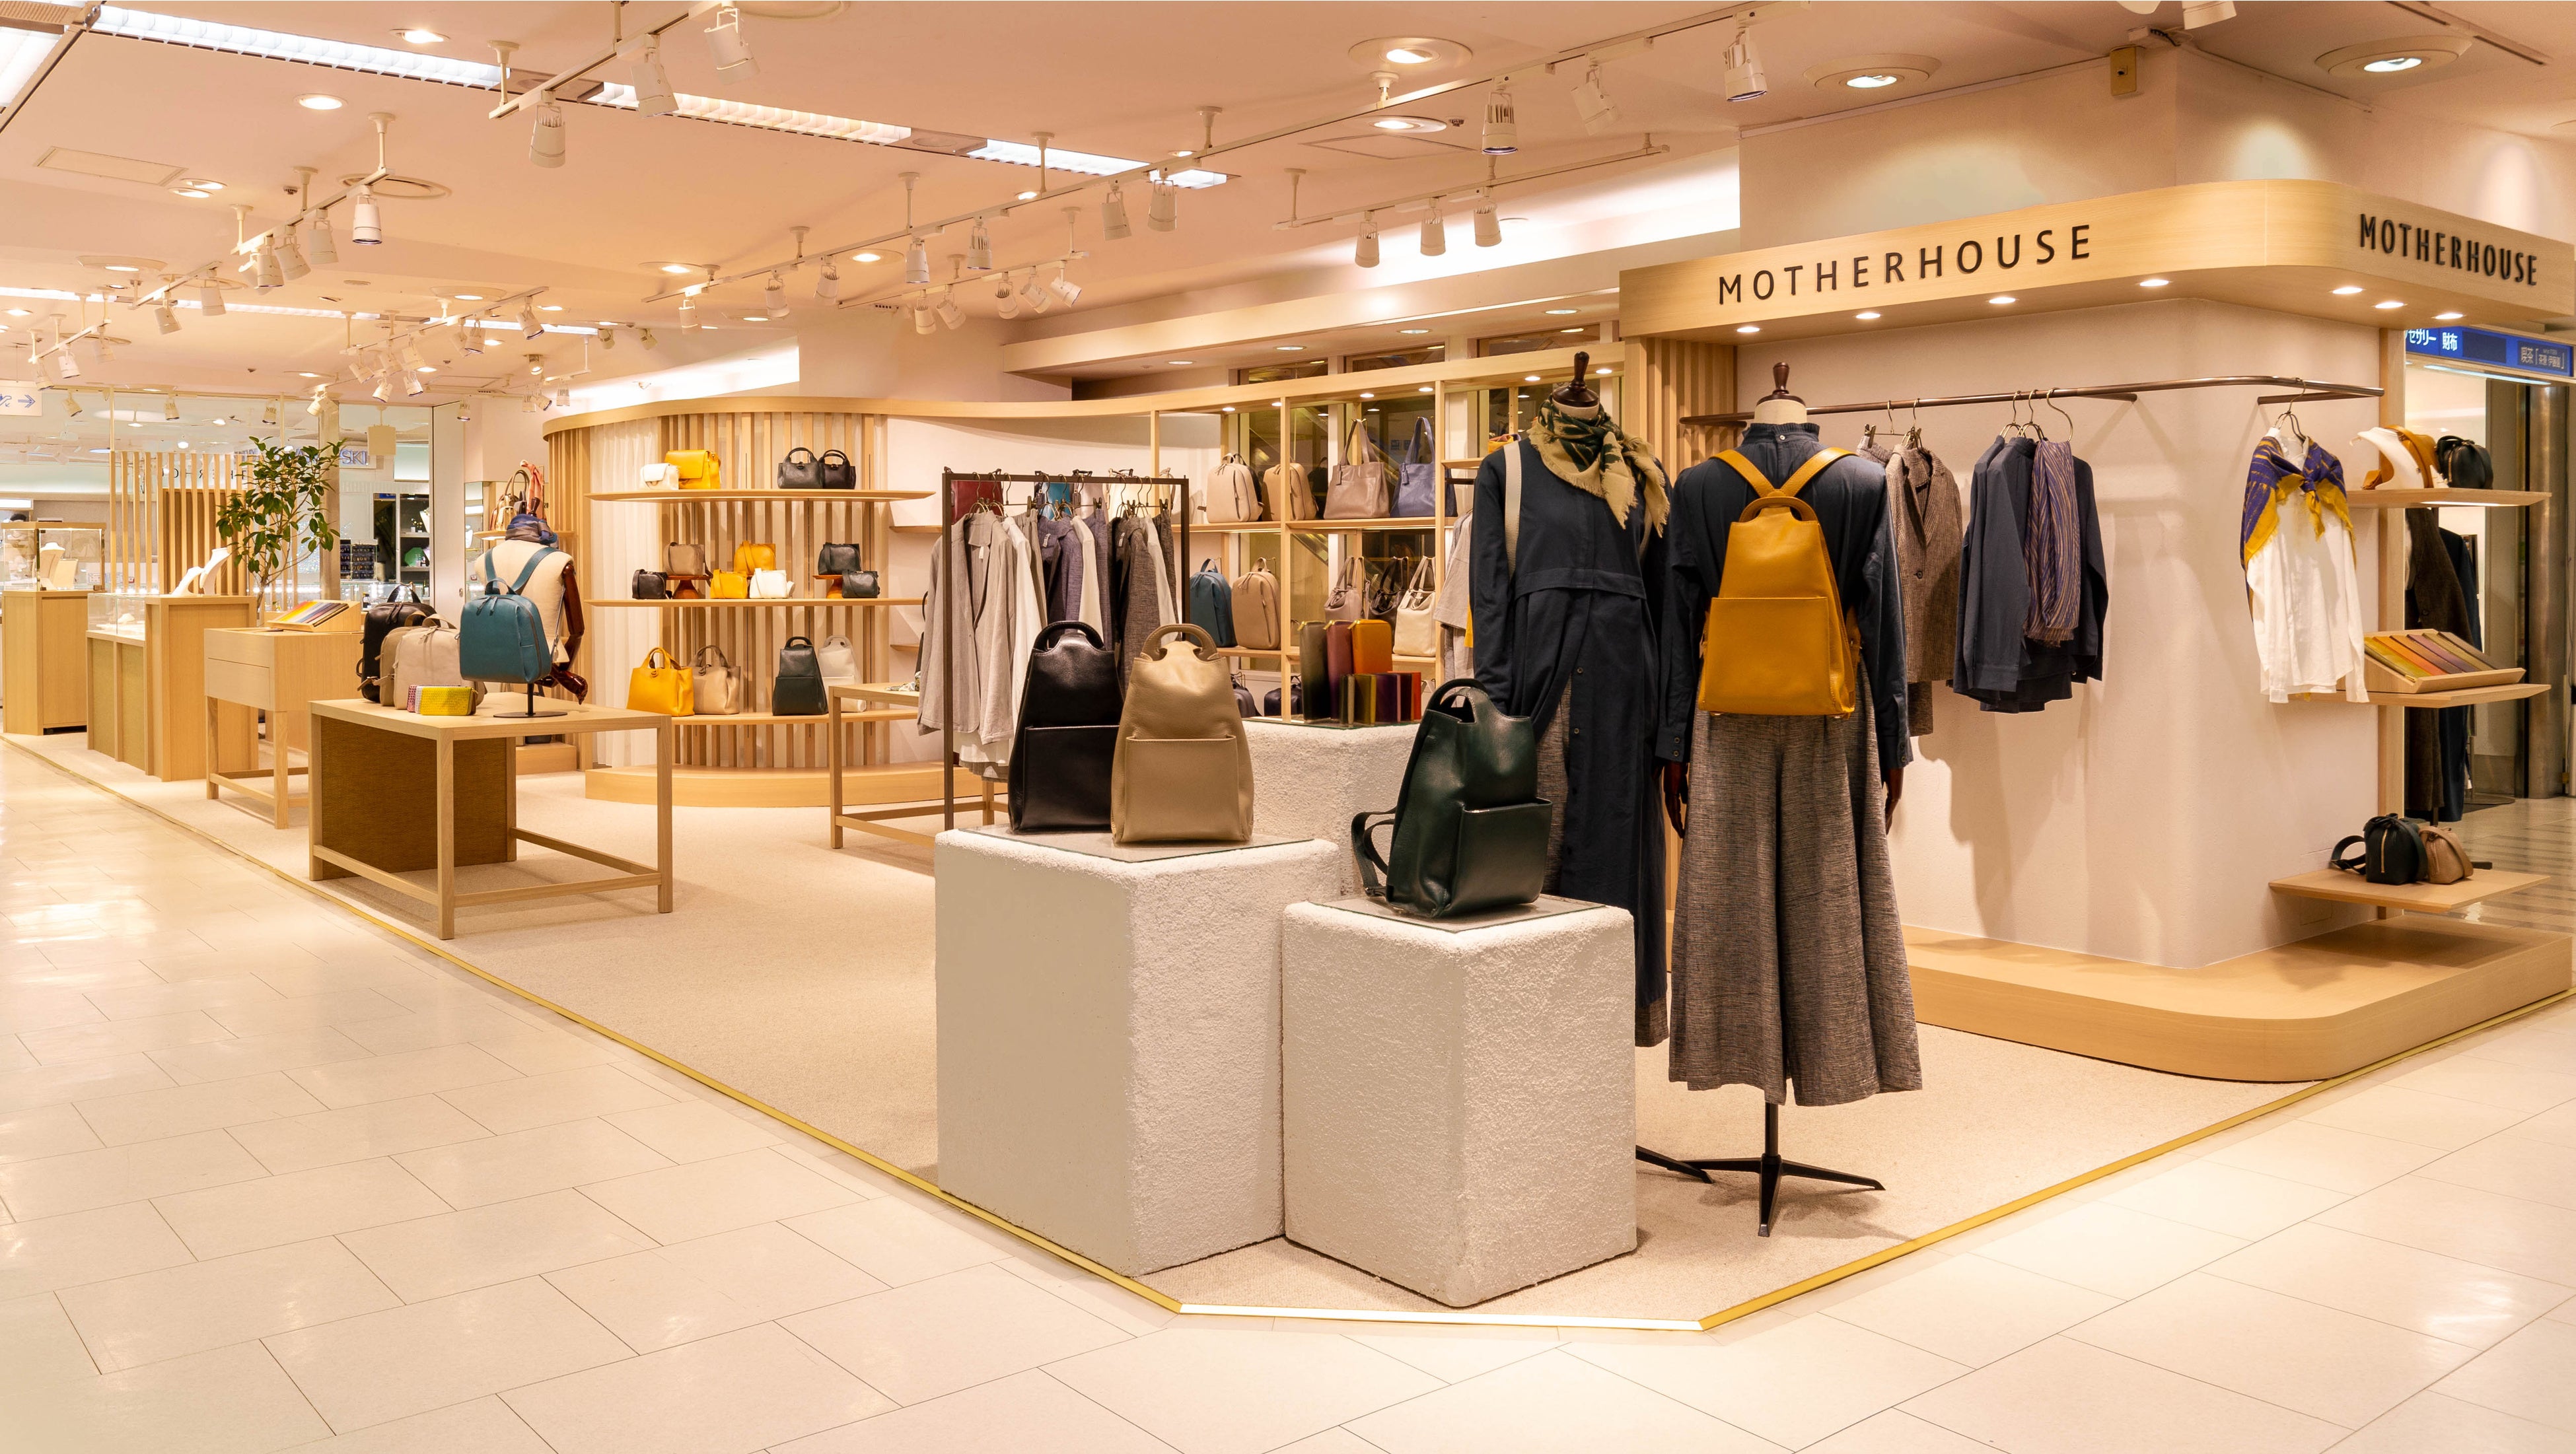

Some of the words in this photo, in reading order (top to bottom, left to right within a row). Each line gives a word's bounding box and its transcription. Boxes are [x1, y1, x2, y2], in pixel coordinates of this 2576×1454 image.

[1719, 224, 2090, 305] MOTHERHOUSE
[2360, 213, 2537, 286] MOTHERHOUSE
[2442, 331, 2458, 351] 財布
